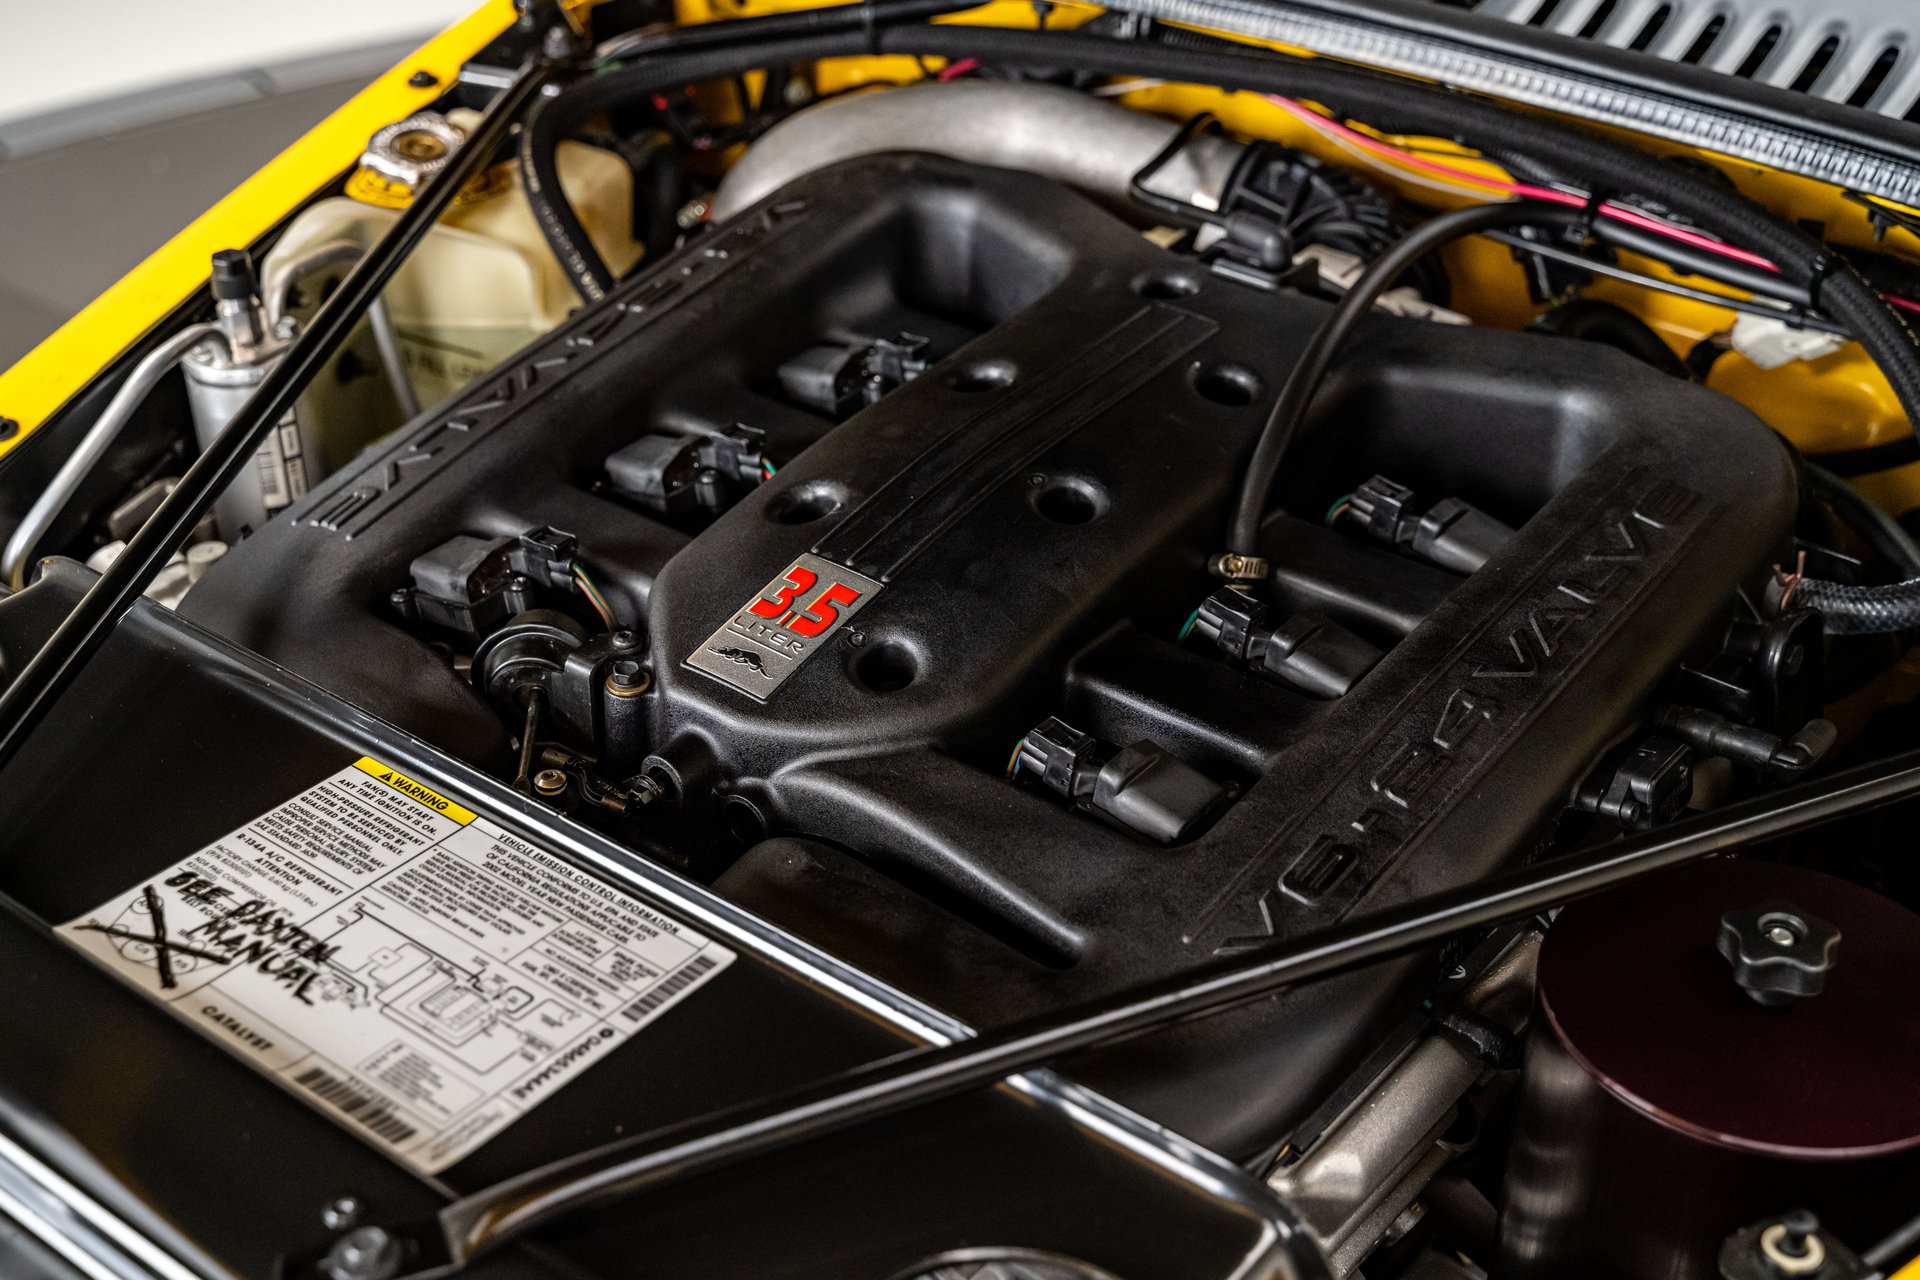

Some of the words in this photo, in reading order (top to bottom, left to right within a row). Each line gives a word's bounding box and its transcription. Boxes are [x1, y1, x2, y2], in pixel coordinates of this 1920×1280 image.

[747, 565, 863, 638] 3.5
[1470, 478, 1706, 680] VALVE
[732, 615, 805, 655] LITER
[307, 790, 338, 807] SYSTEM
[356, 817, 396, 840] SERVICED
[393, 838, 407, 846] BY
[316, 785, 375, 818] HIGH-PRESSURE
[372, 816, 425, 846] REFRIGERANT
[337, 778, 357, 789] ANY
[355, 788, 376, 799] TIME
[373, 798, 413, 820] IGNITION
[420, 823, 439, 834] ON.
[360, 781, 389, 797] FAN(S)
[387, 795, 408, 807] MAY
[406, 805, 434, 821] START
[390, 777, 450, 810] WARNING
[299, 795, 339, 818] QUALIFIED
[336, 817, 382, 842] PERSONNEL
[380, 841, 404, 855] ONLY.
[235, 833, 267, 851] R-134A
[264, 850, 285, 862] A/C
[282, 860, 343, 895] REFRIGERANT
[254, 856, 303, 885] ATTENTION
[496, 833, 534, 855] VEHICLE
[531, 852, 575, 877] EMISSION
[572, 874, 618, 900] CONTROL
[615, 897, 681, 934] INFORMATION
[180, 895, 201, 908] BELT
[186, 914, 317, 1007] MANUAL
[199, 1004, 273, 1051] CATALYST
